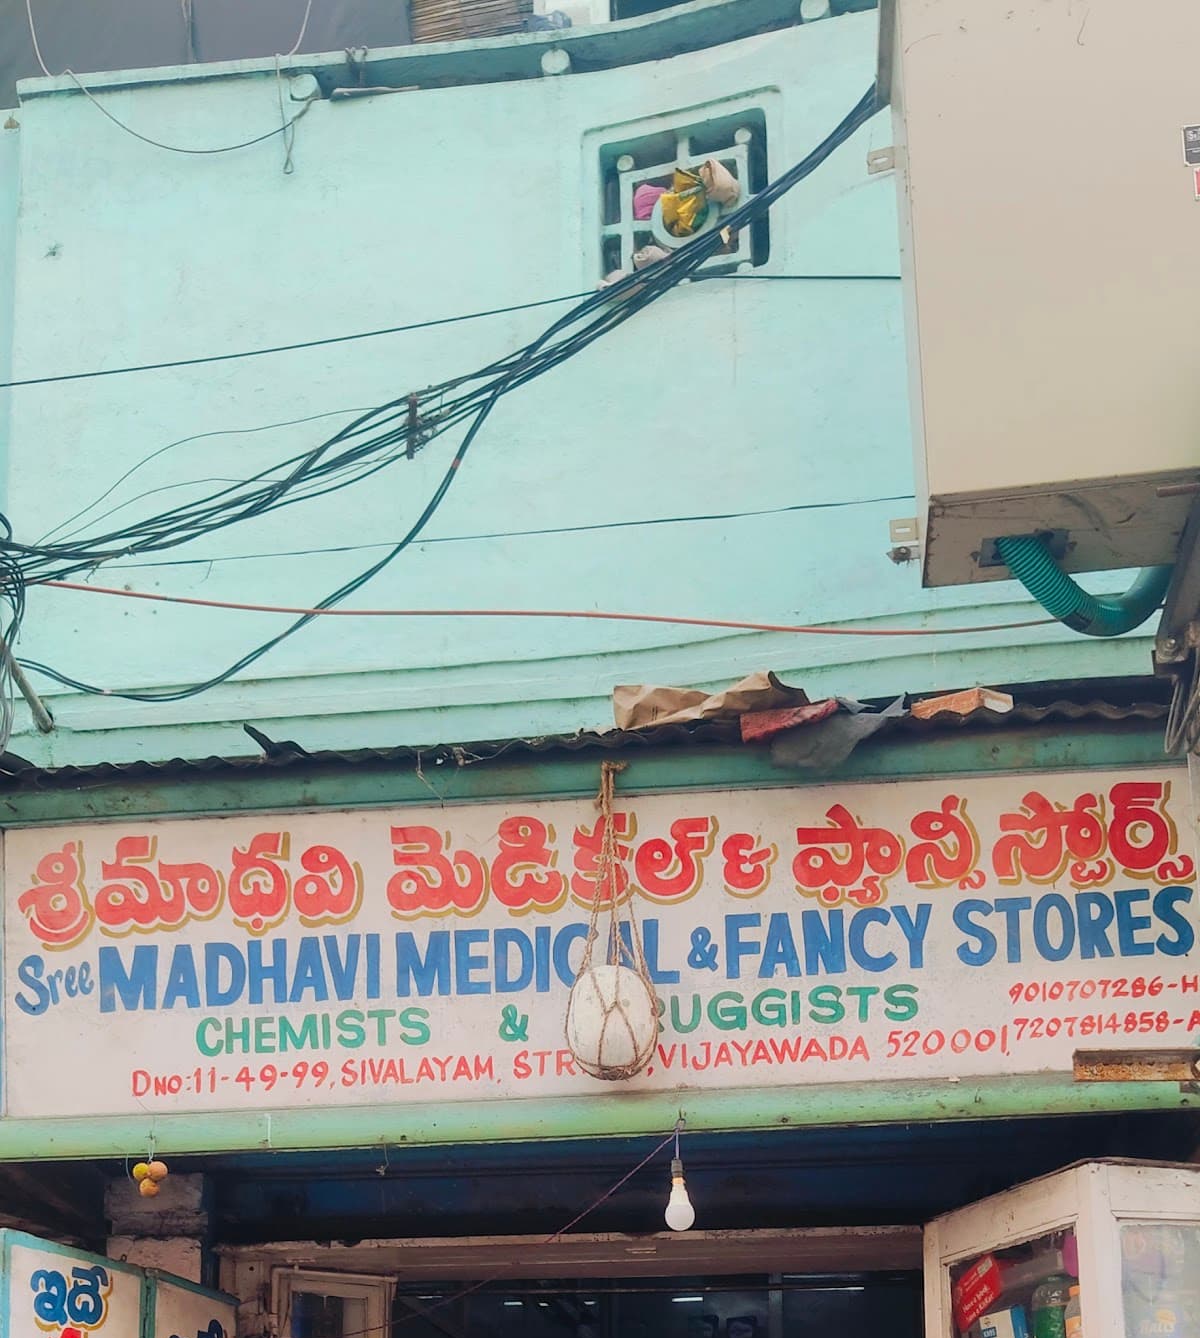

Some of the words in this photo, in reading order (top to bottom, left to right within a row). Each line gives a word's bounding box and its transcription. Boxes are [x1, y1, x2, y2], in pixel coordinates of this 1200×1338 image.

[14, 954, 94, 1016] Sree
[99, 932, 381, 1014] MADHAVI
[686, 926, 719, 972] &
[725, 903, 933, 981] FANCY
[953, 886, 1195, 967] STORES
[196, 1006, 431, 1057] CHEMISTS
[498, 1003, 530, 1043] &
[653, 982, 919, 1034] UGGISTS
[30, 1265, 113, 1331] ఇదే
